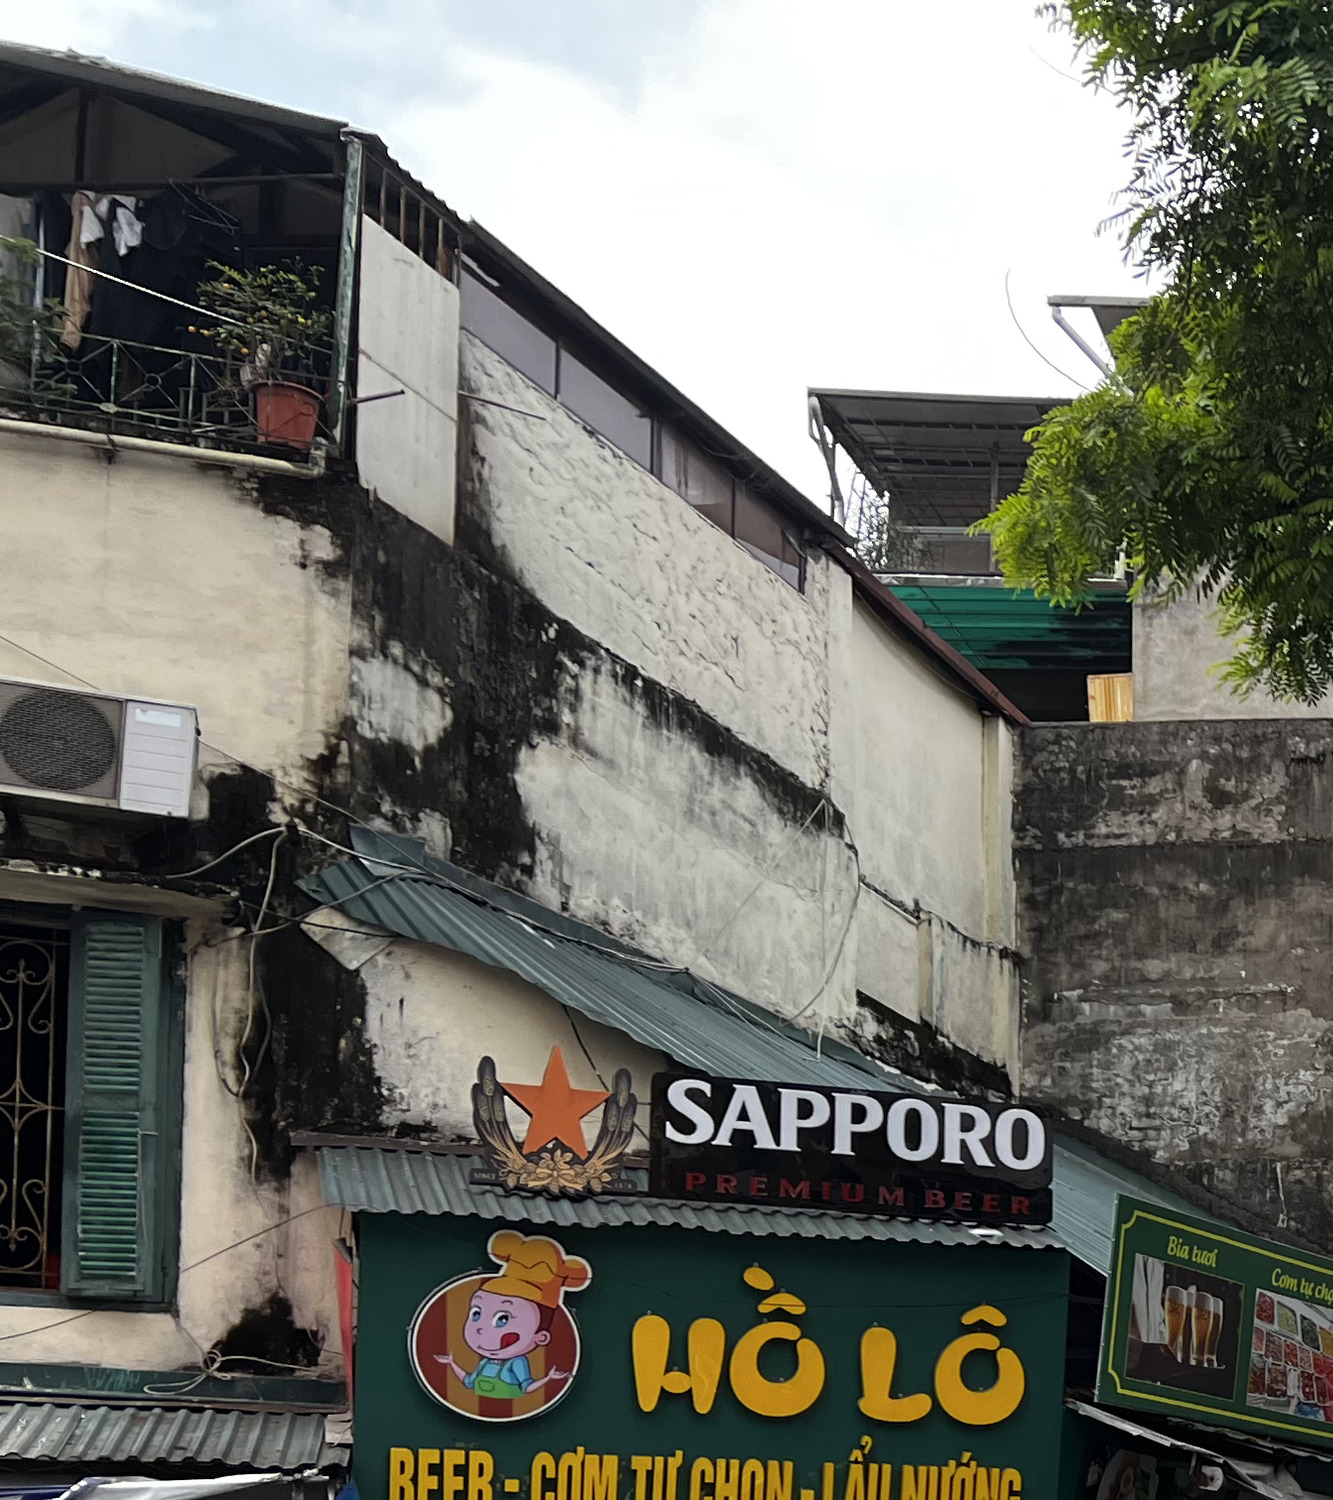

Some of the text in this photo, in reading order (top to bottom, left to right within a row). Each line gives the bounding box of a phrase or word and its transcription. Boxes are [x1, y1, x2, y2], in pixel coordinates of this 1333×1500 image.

[665, 1079, 1046, 1171] SAPPORO
[685, 1172, 1032, 1216] PREMIUM BEER
[1167, 1236, 1219, 1268] Bia tươi
[1271, 1267, 1299, 1292] Cơm
[632, 1266, 1026, 1426] HỒ LÔ
